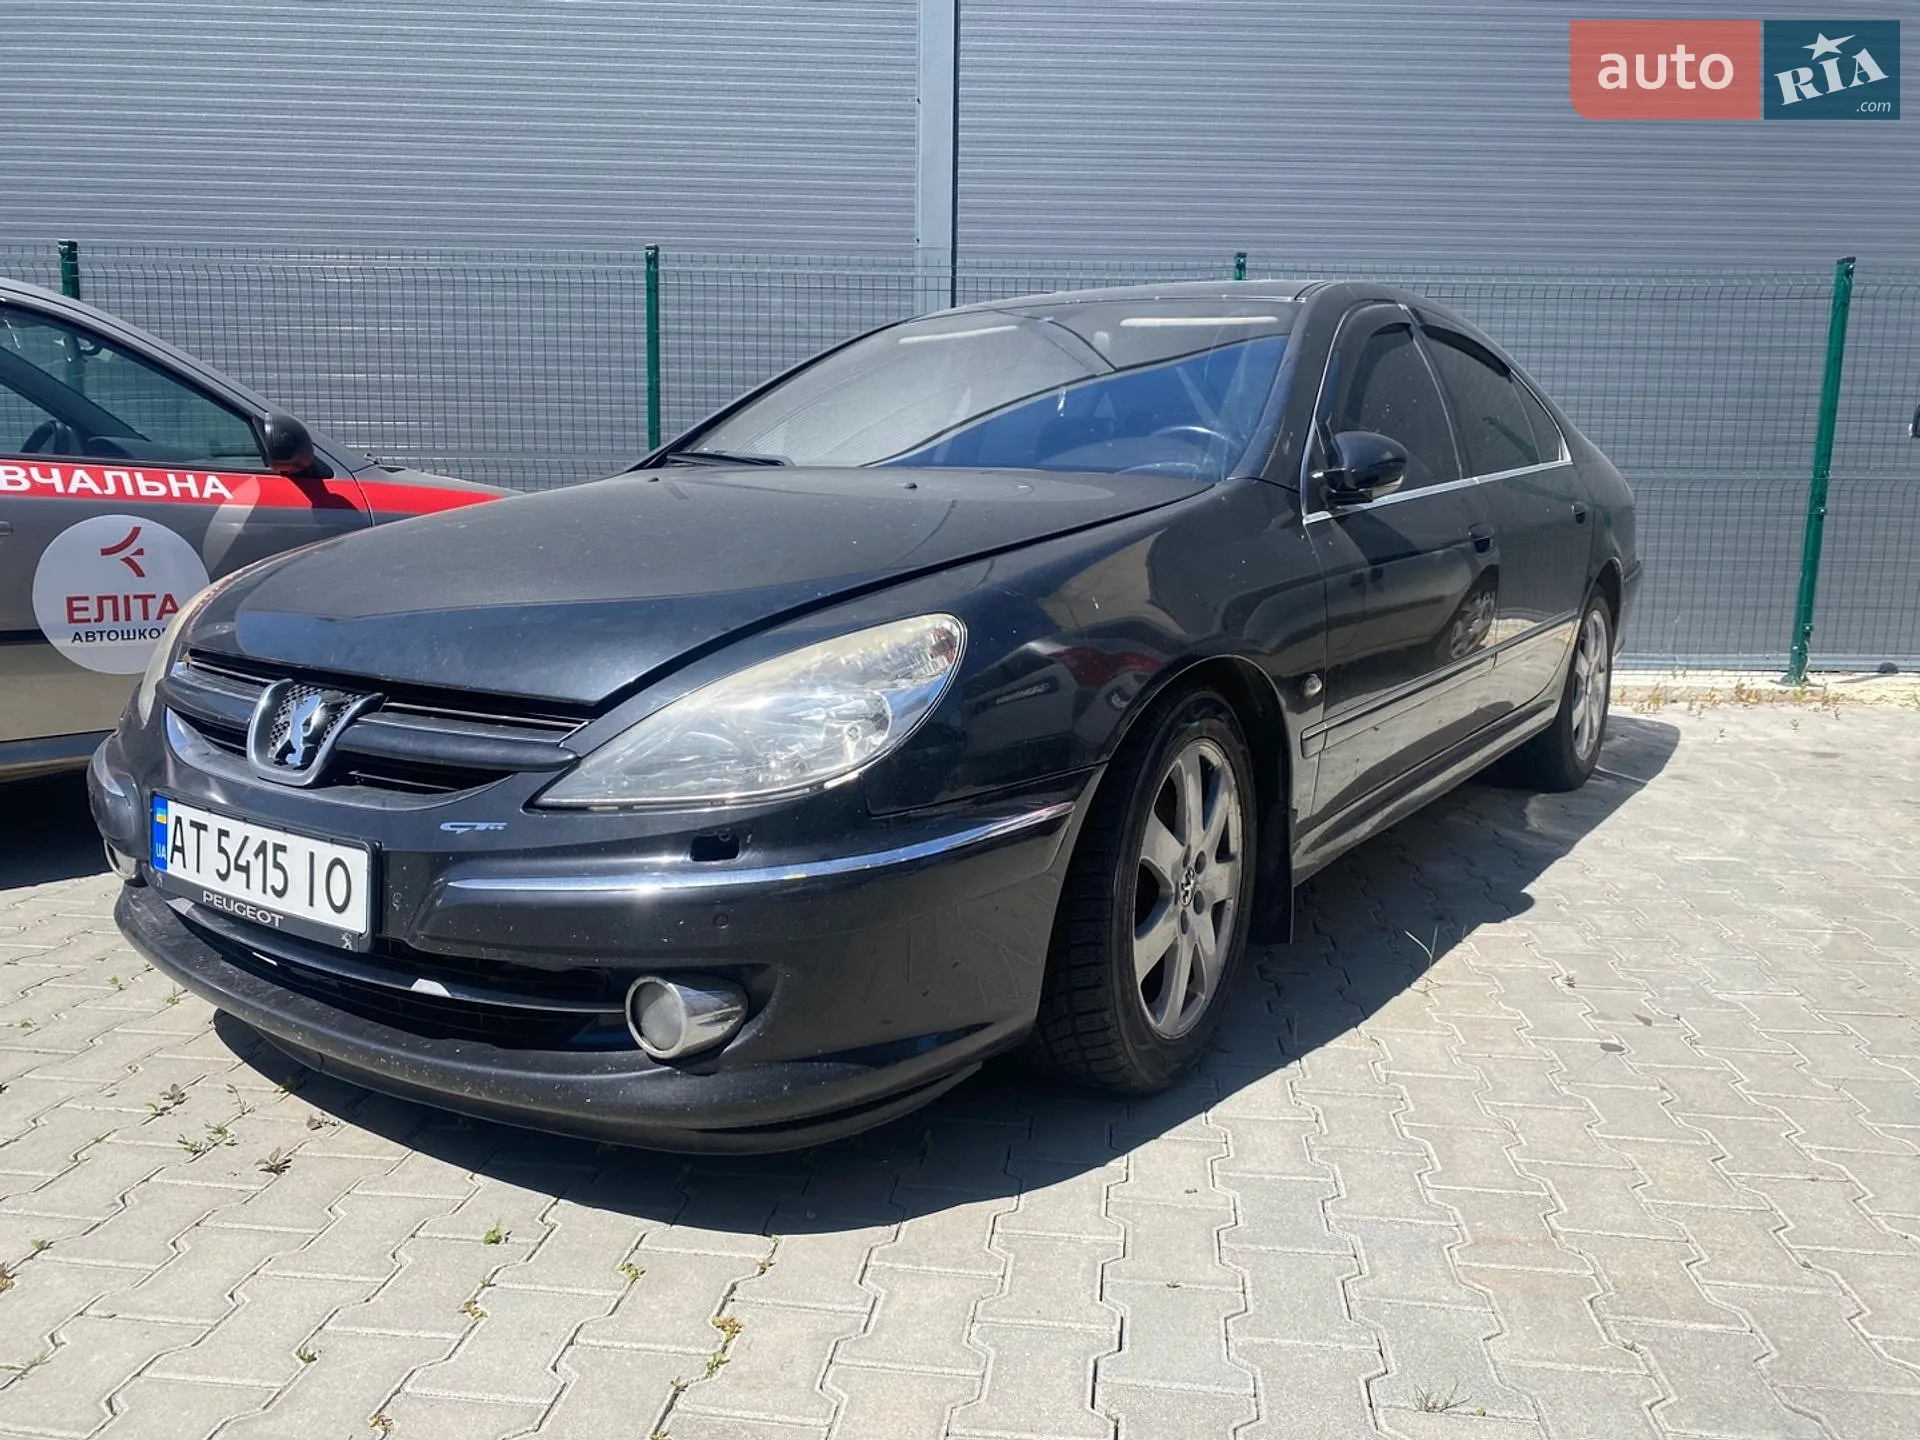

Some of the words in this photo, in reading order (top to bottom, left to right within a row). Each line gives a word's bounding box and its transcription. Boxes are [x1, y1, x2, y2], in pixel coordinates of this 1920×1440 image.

[0, 465, 234, 499] ВЧАЛЬНА
[66, 593, 180, 624] ЕЛІТА
[71, 628, 166, 643] АВТОШКО
[155, 843, 167, 860] UA
[170, 815, 208, 874] AT
[215, 828, 289, 898] 5415
[307, 851, 352, 914] IO
[202, 890, 284, 927] PEUGEOT
